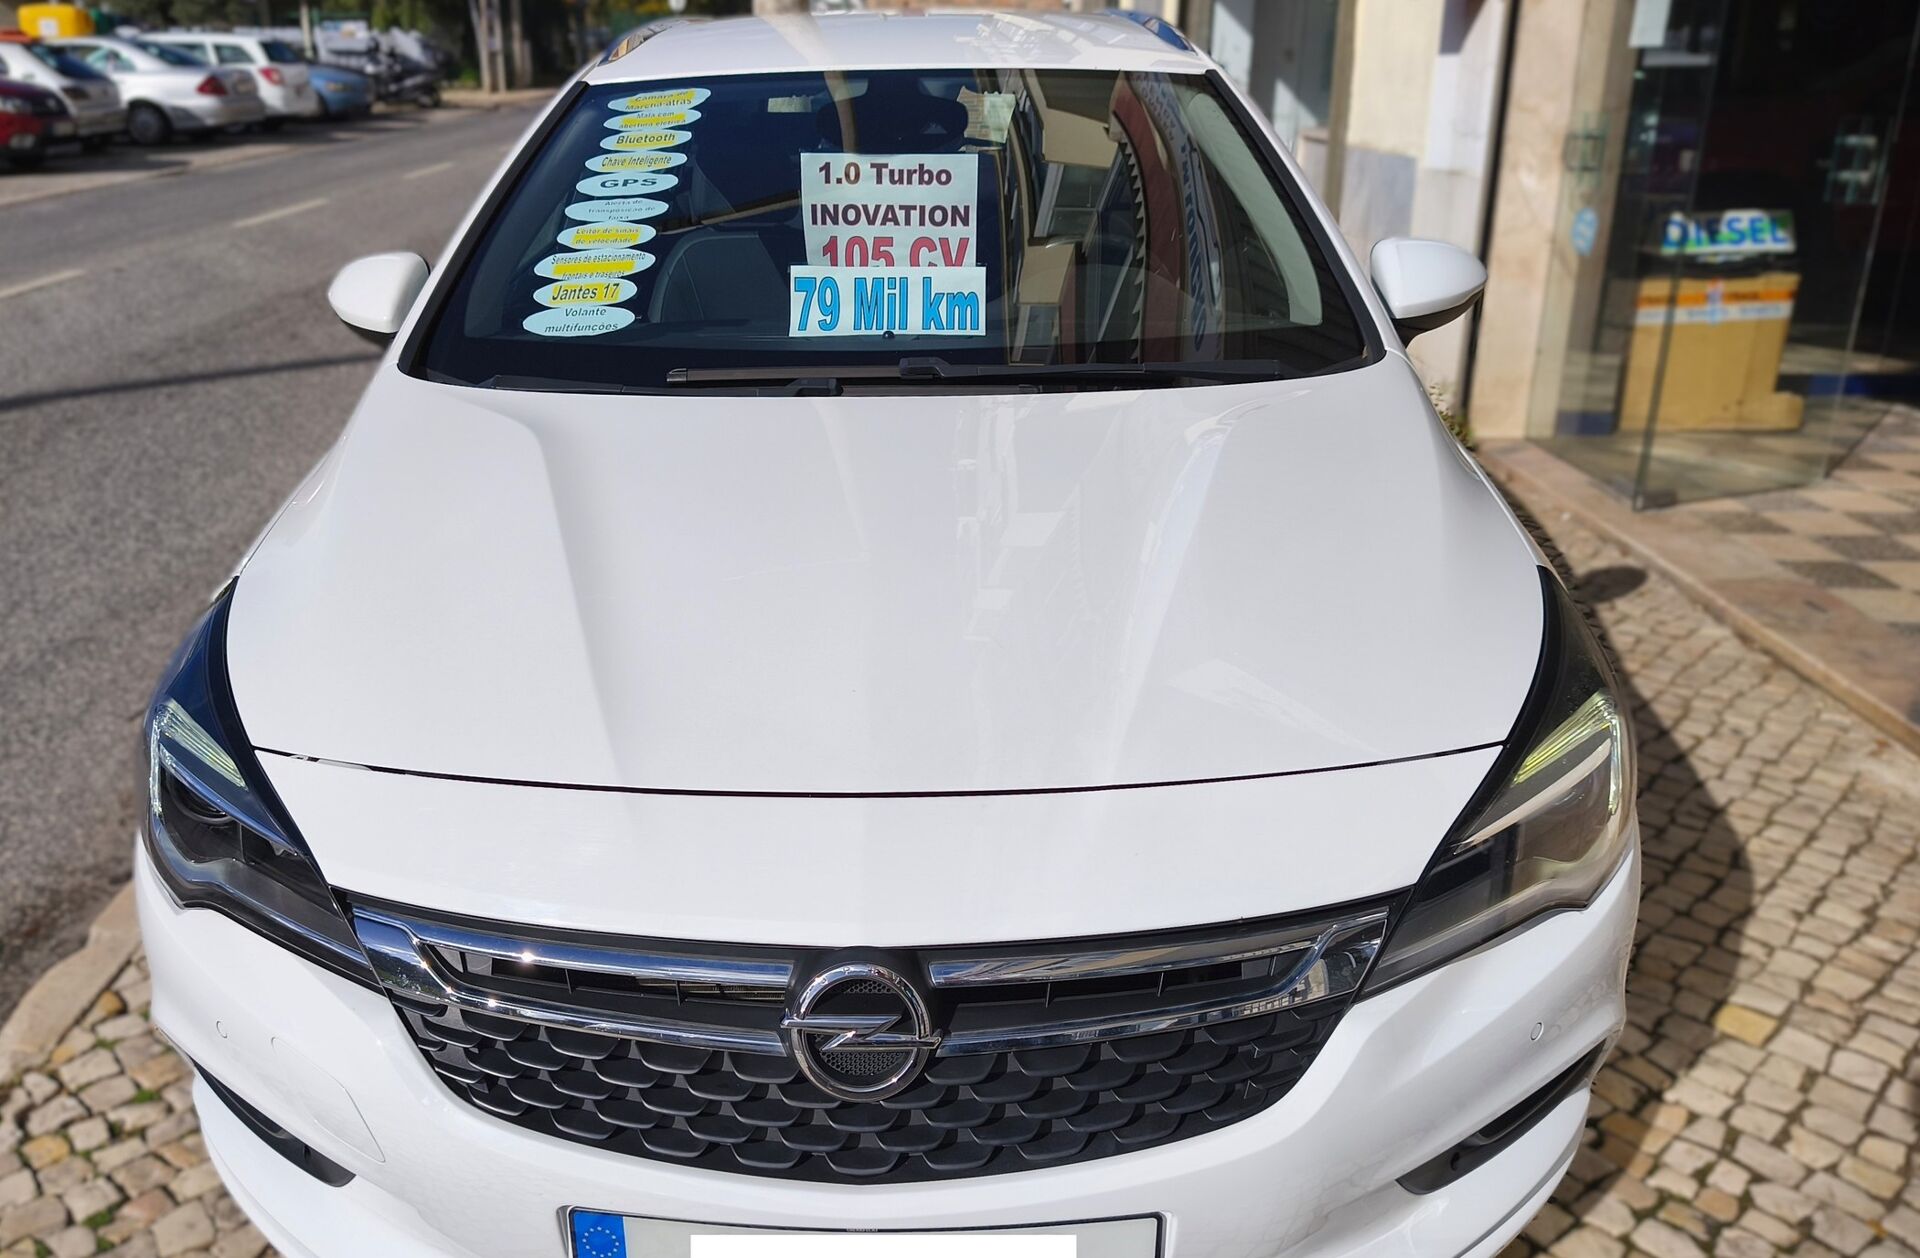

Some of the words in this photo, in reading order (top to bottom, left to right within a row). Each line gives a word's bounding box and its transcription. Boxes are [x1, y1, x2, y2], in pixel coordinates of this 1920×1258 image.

[616, 132, 676, 145] Bluetooth
[602, 156, 627, 167] Chave
[628, 155, 672, 168] Inteligente
[818, 161, 861, 185] 1.0
[869, 162, 953, 186] Turbo
[600, 178, 658, 188] GPS
[810, 203, 971, 227] INOVATION
[1663, 216, 1790, 247] DIESEL
[551, 255, 582, 265] Sensores
[583, 254, 591, 263] de
[592, 253, 646, 263] estacionamento
[822, 235, 895, 267] 105
[908, 236, 970, 267] CV
[561, 272, 588, 280] frontais
[595, 270, 625, 278] traseiros
[552, 285, 598, 301] Jantes
[603, 282, 620, 299] 17
[564, 307, 607, 317] Volante
[793, 276, 841, 332] 79
[853, 276, 909, 331] Mil
[921, 276, 980, 331] km
